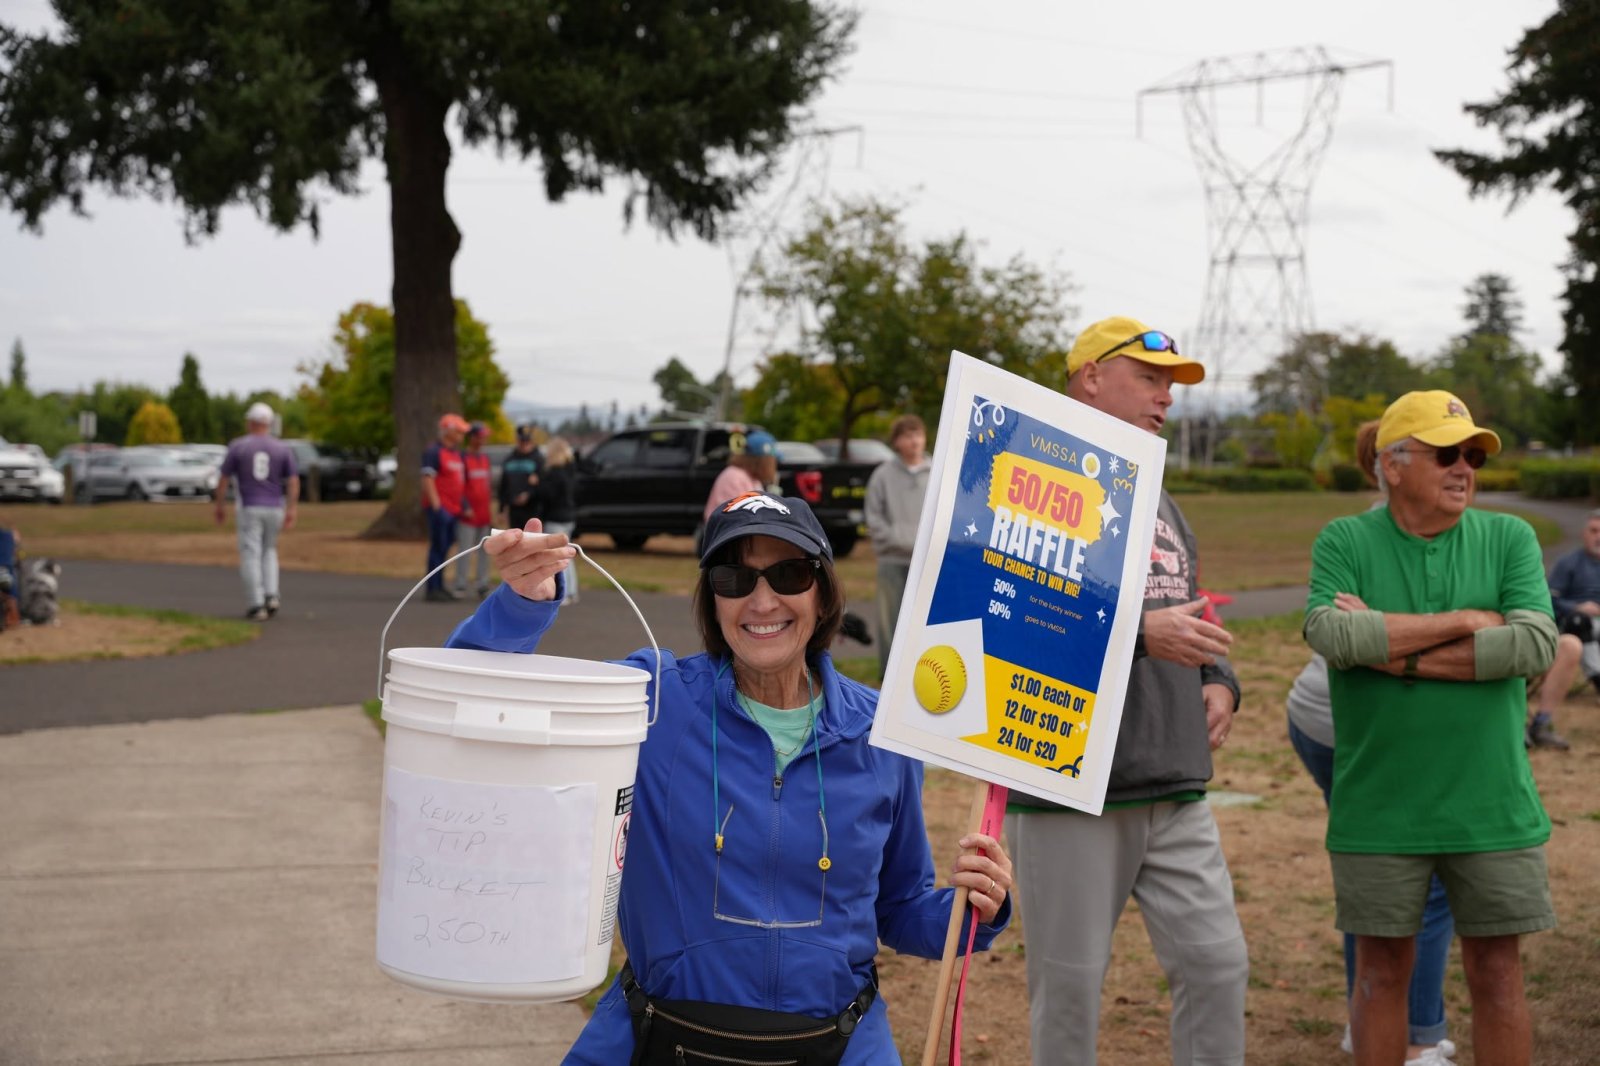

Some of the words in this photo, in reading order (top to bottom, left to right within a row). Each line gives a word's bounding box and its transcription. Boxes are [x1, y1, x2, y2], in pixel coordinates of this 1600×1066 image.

[1030, 433, 1077, 466] VMSSA
[1007, 465, 1084, 529] 50/50
[989, 505, 1087, 582] RAFFLE
[983, 548, 1004, 568] YOUR
[1004, 558, 1035, 581] CHANCE
[1036, 569, 1047, 585] TO
[1047, 574, 1064, 592] WIN
[1064, 580, 1081, 599] BIG!
[993, 578, 1016, 599] 50%
[988, 599, 1011, 620] 50%
[1024, 615, 1040, 625] goes
[1047, 623, 1067, 635] VMSSA
[1029, 595, 1038, 604] for
[1039, 599, 1049, 608] the
[1048, 602, 1064, 615] lucky
[1063, 608, 1084, 621] winner
[1010, 673, 1042, 698] $1.00
[1042, 685, 1072, 709] each
[1072, 696, 1087, 714] or
[1004, 699, 1019, 720] 12
[1019, 704, 1038, 726] for
[1038, 712, 1059, 733] $10
[1059, 721, 1074, 738] or
[997, 726, 1015, 748] 24
[1015, 732, 1034, 754] for
[1034, 740, 1058, 762] $20
[425, 827, 487, 853] TIP
